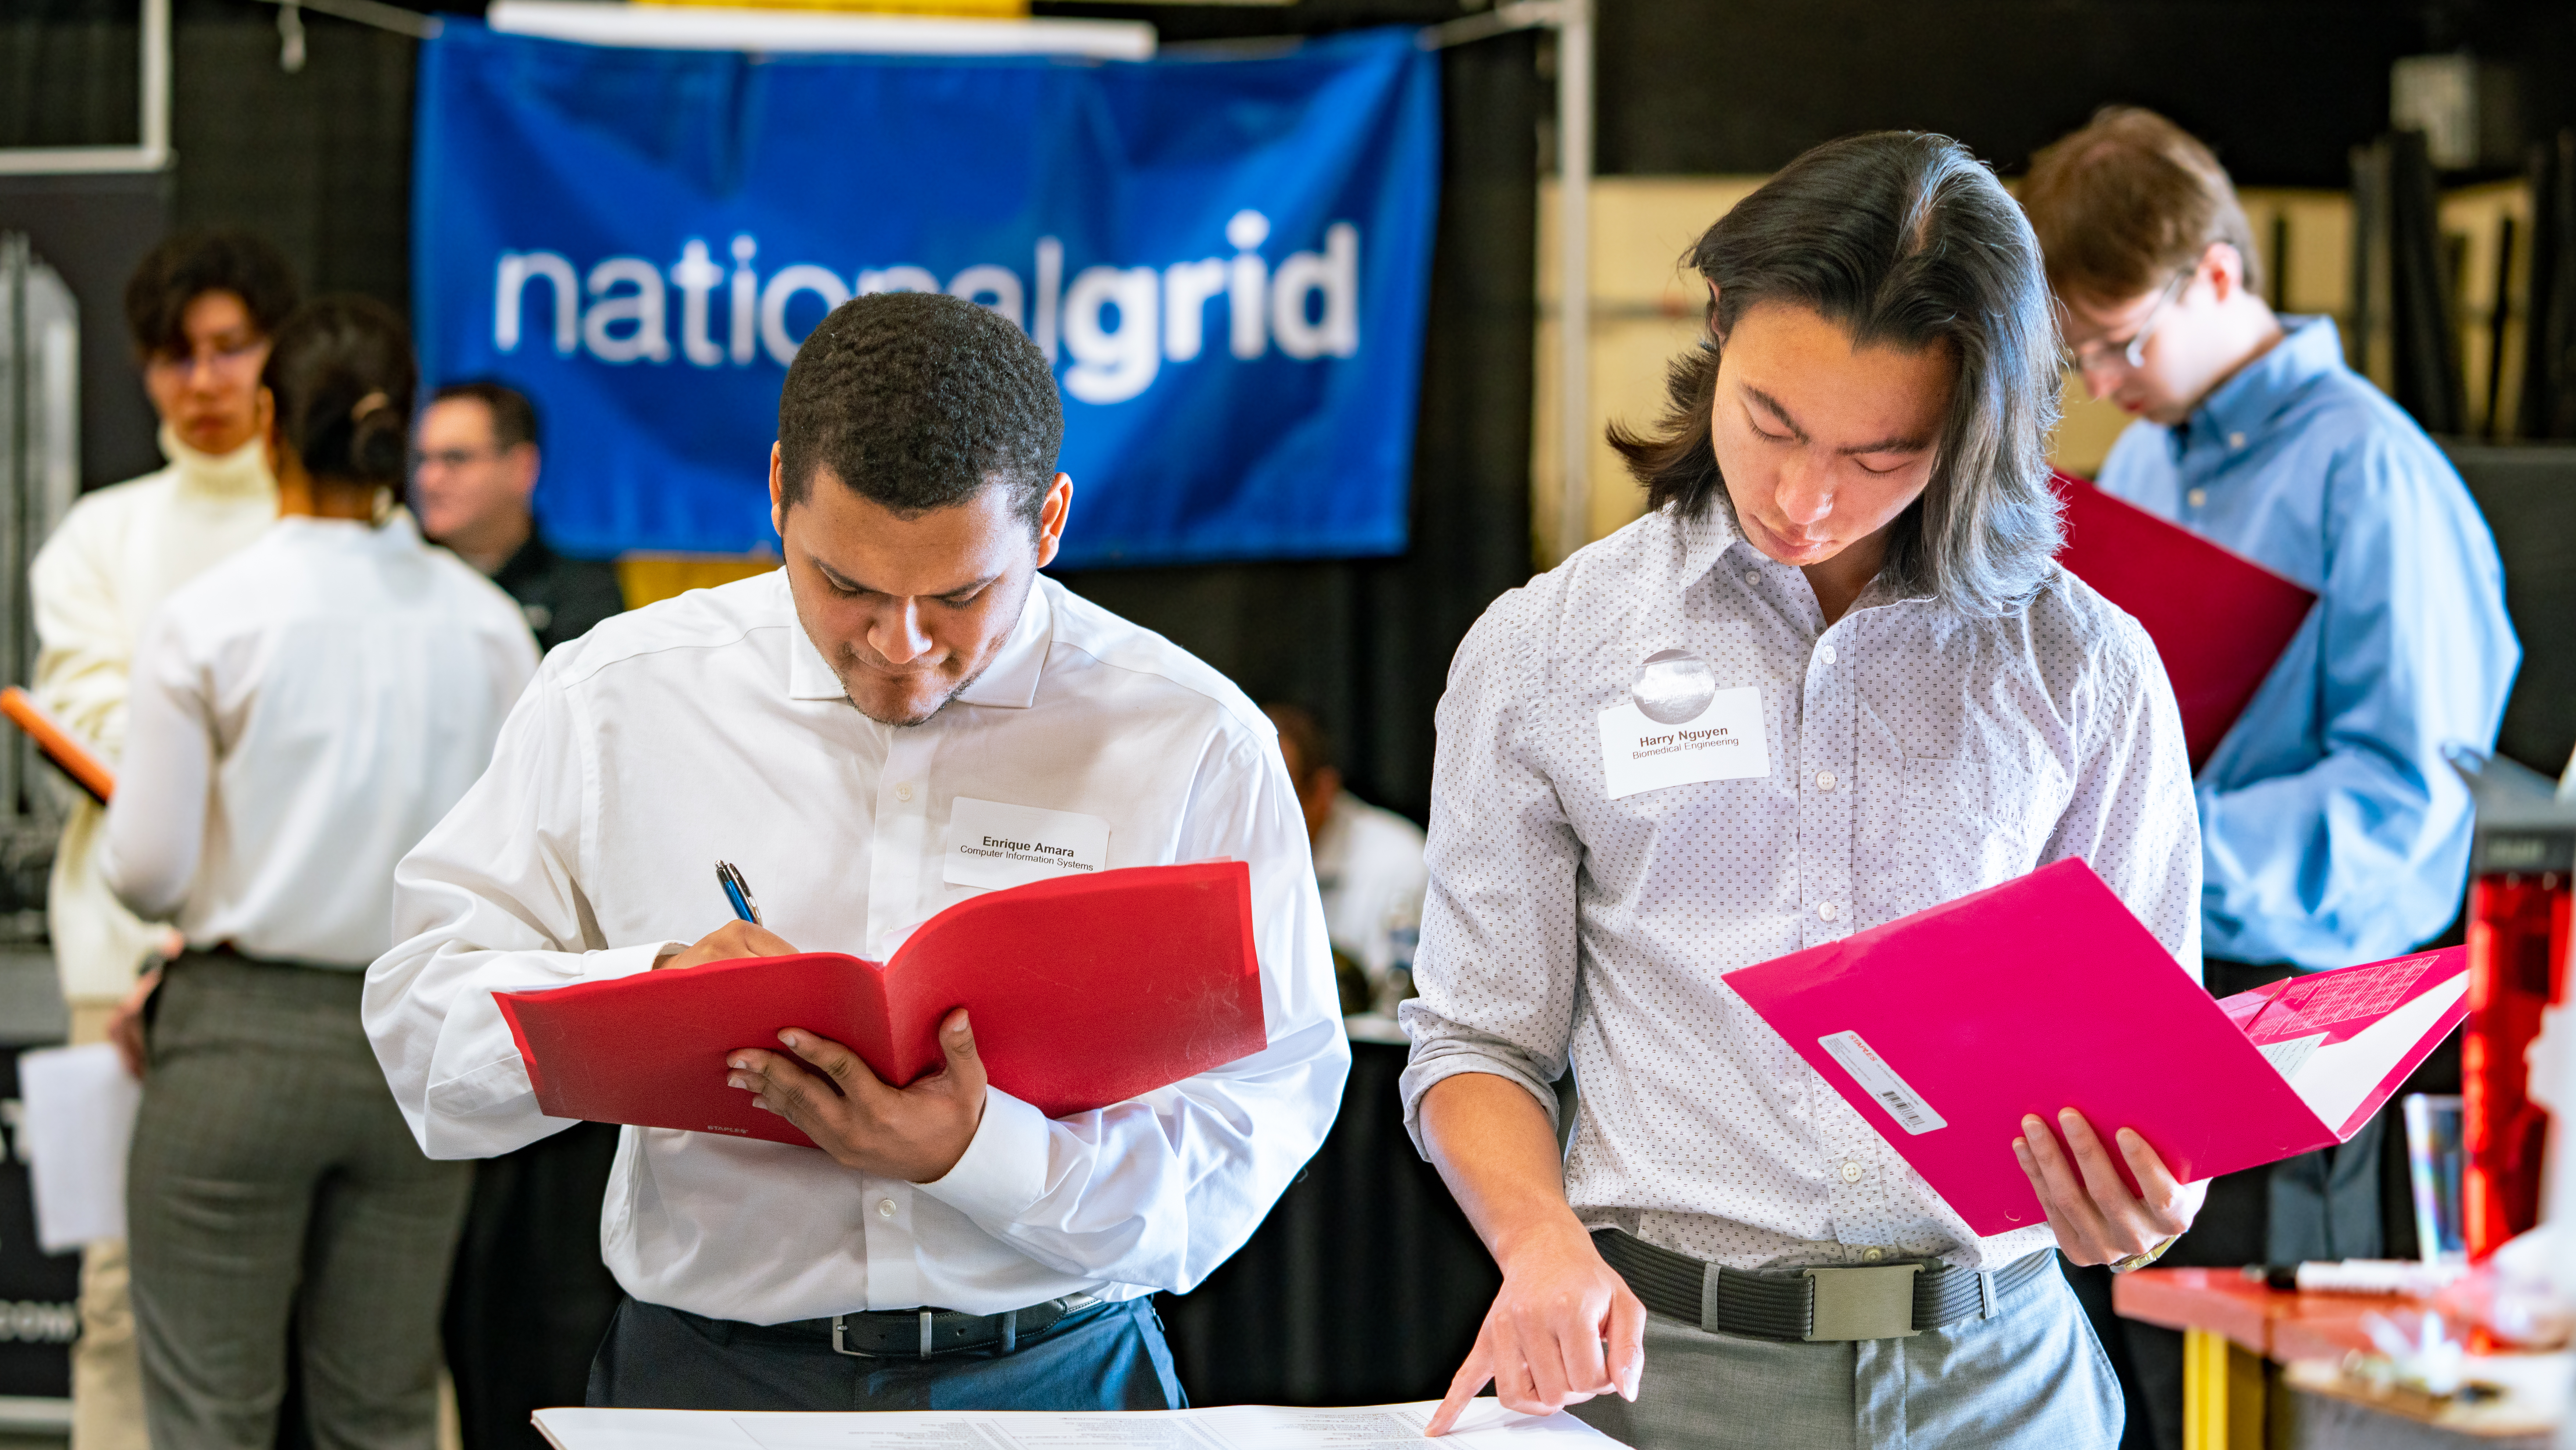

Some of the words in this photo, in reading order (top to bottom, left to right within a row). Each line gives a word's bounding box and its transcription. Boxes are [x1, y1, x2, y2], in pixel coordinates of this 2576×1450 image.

[494, 210, 1360, 404] natiolgrid
[1641, 669, 1707, 690] Biomedical
[1643, 685, 1710, 705] Engineering
[1639, 734, 1674, 747] Harry
[1678, 727, 1728, 742] Nguyen
[1632, 743, 1681, 760] Biomedical
[1684, 738, 1739, 750] Engineering
[983, 836, 1031, 852] Enrique
[1034, 843, 1074, 857] Amara
[960, 845, 1003, 858] Computer
[1006, 851, 1054, 864] Information
[1057, 858, 1094, 871] Systems
[1848, 1034, 1877, 1062] STAPLES
